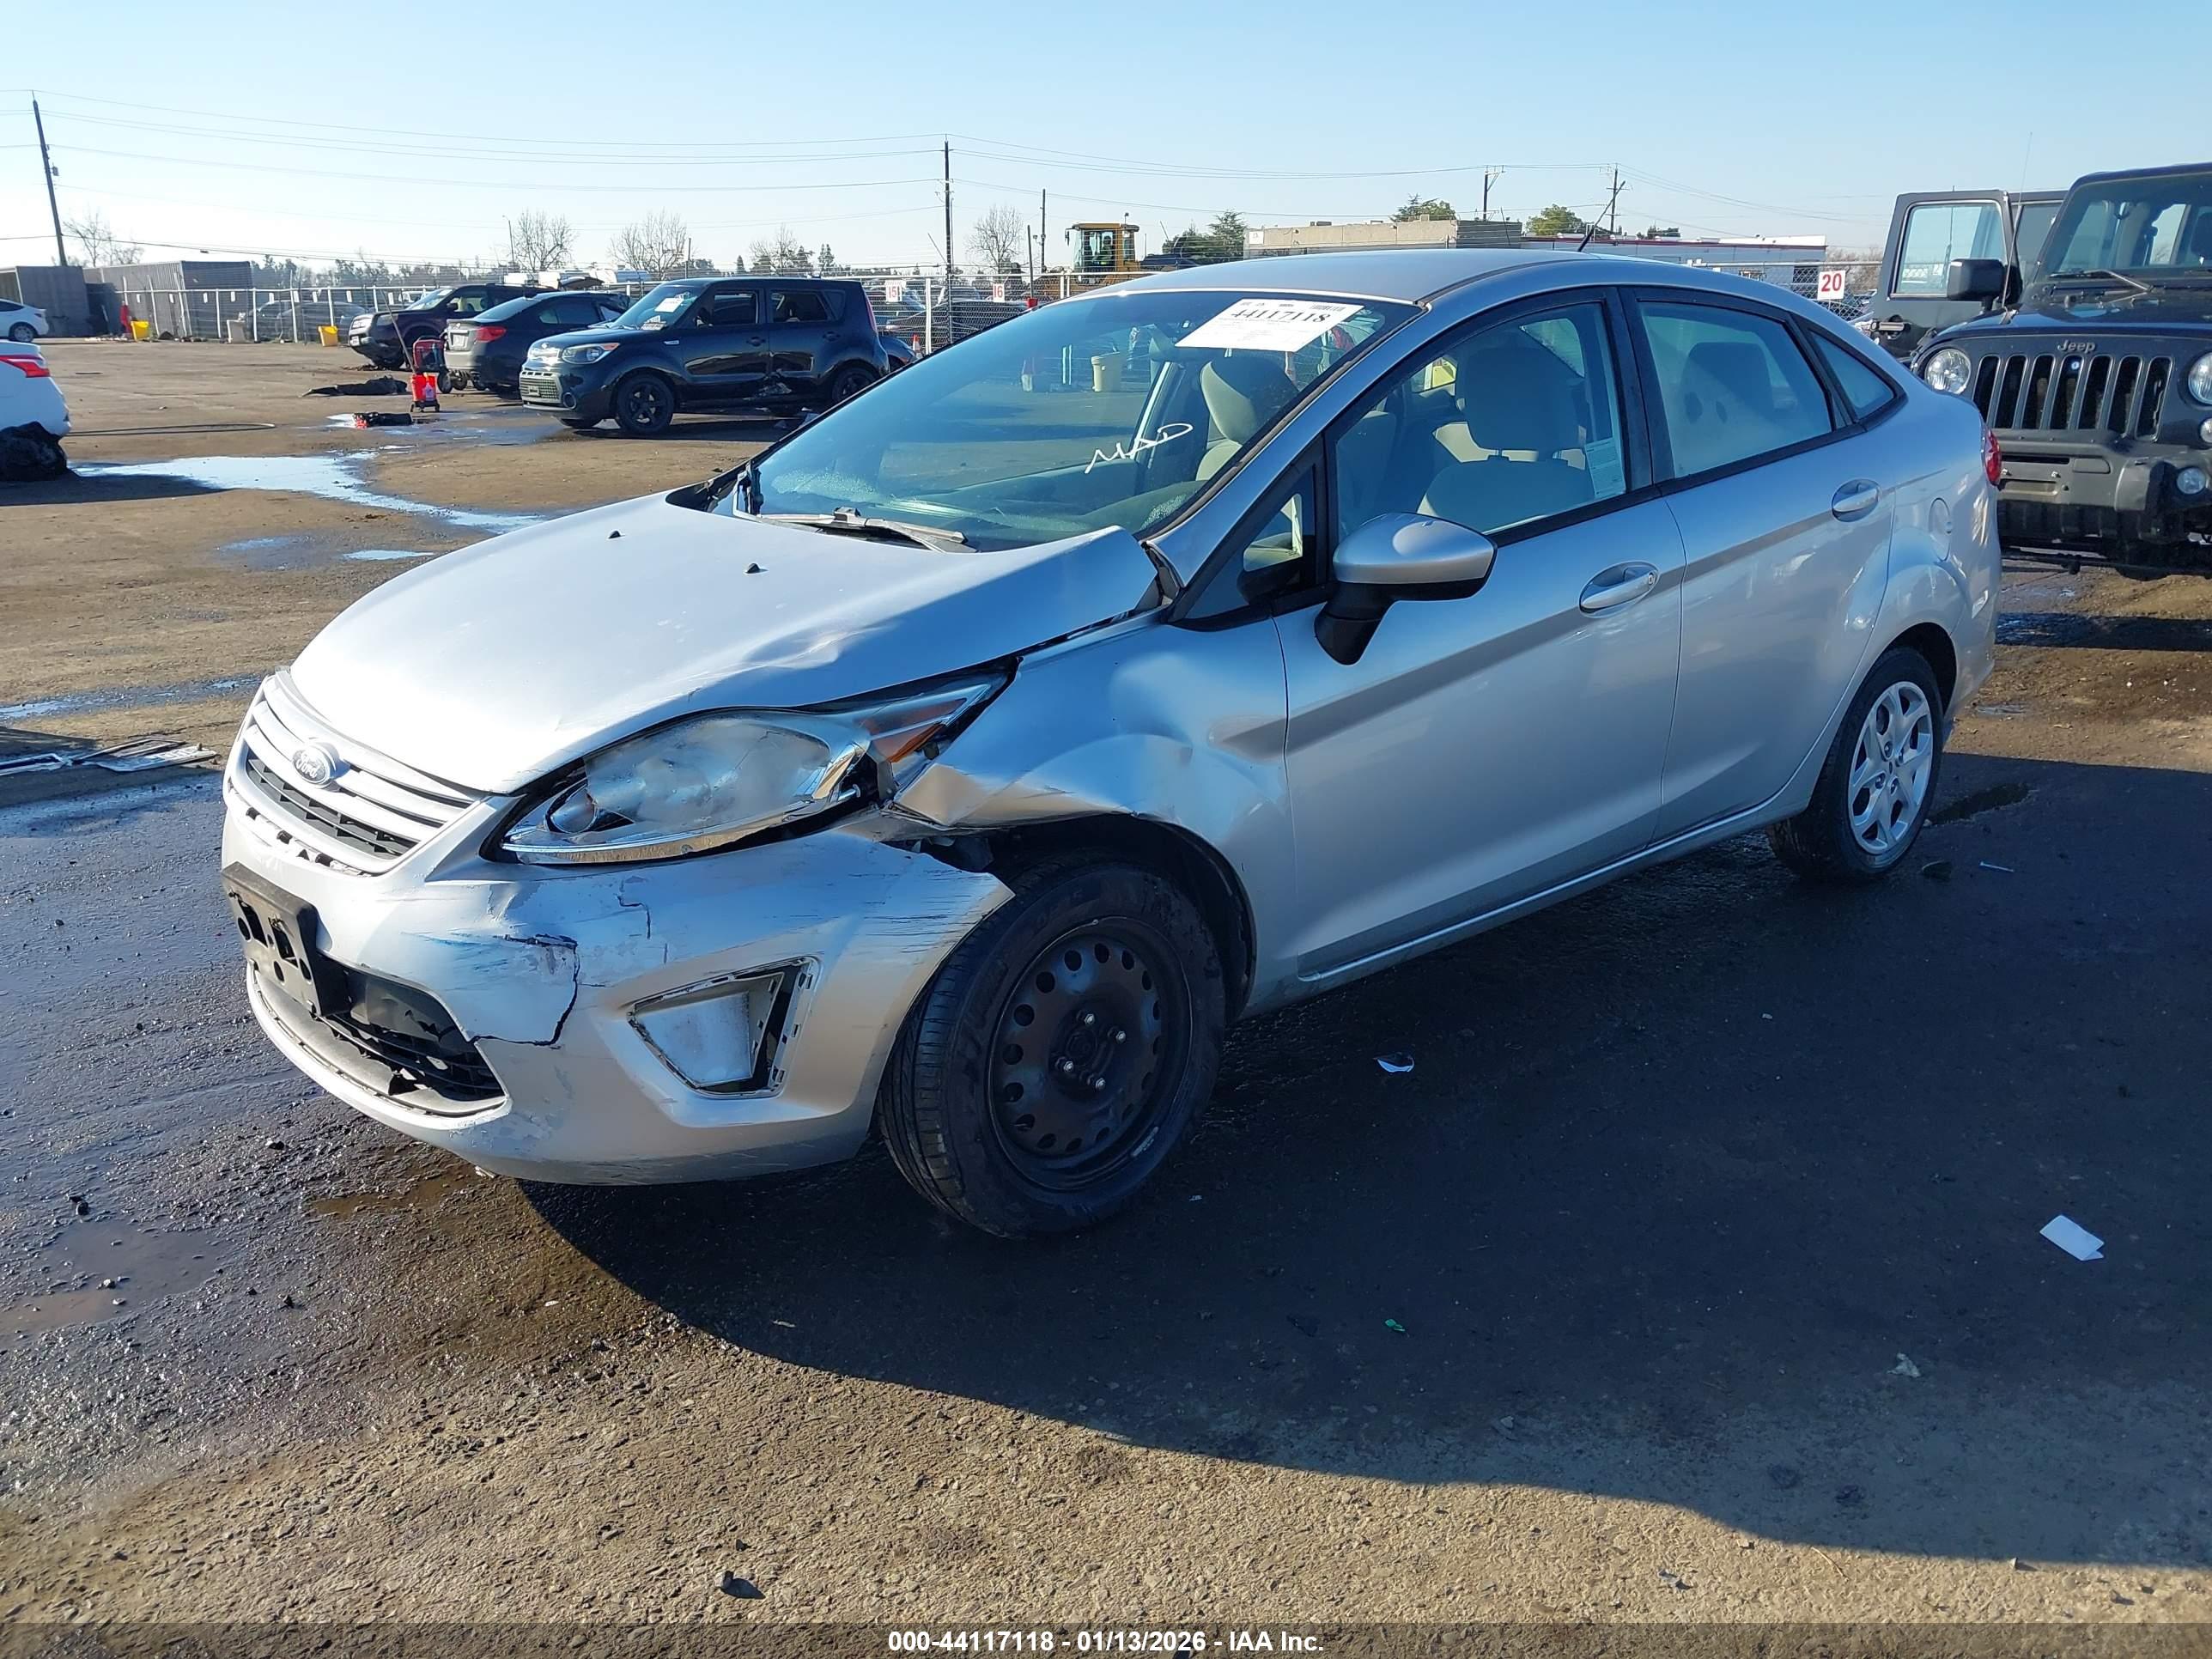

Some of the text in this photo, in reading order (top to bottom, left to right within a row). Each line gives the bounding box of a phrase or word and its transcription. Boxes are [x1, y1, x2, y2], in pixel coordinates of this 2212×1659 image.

[1821, 273, 1842, 292] 20
[994, 285, 1003, 298] 16
[1231, 309, 1331, 323] 44117118
[2057, 339, 2095, 354] Jeep
[296, 749, 321, 778] Ford
